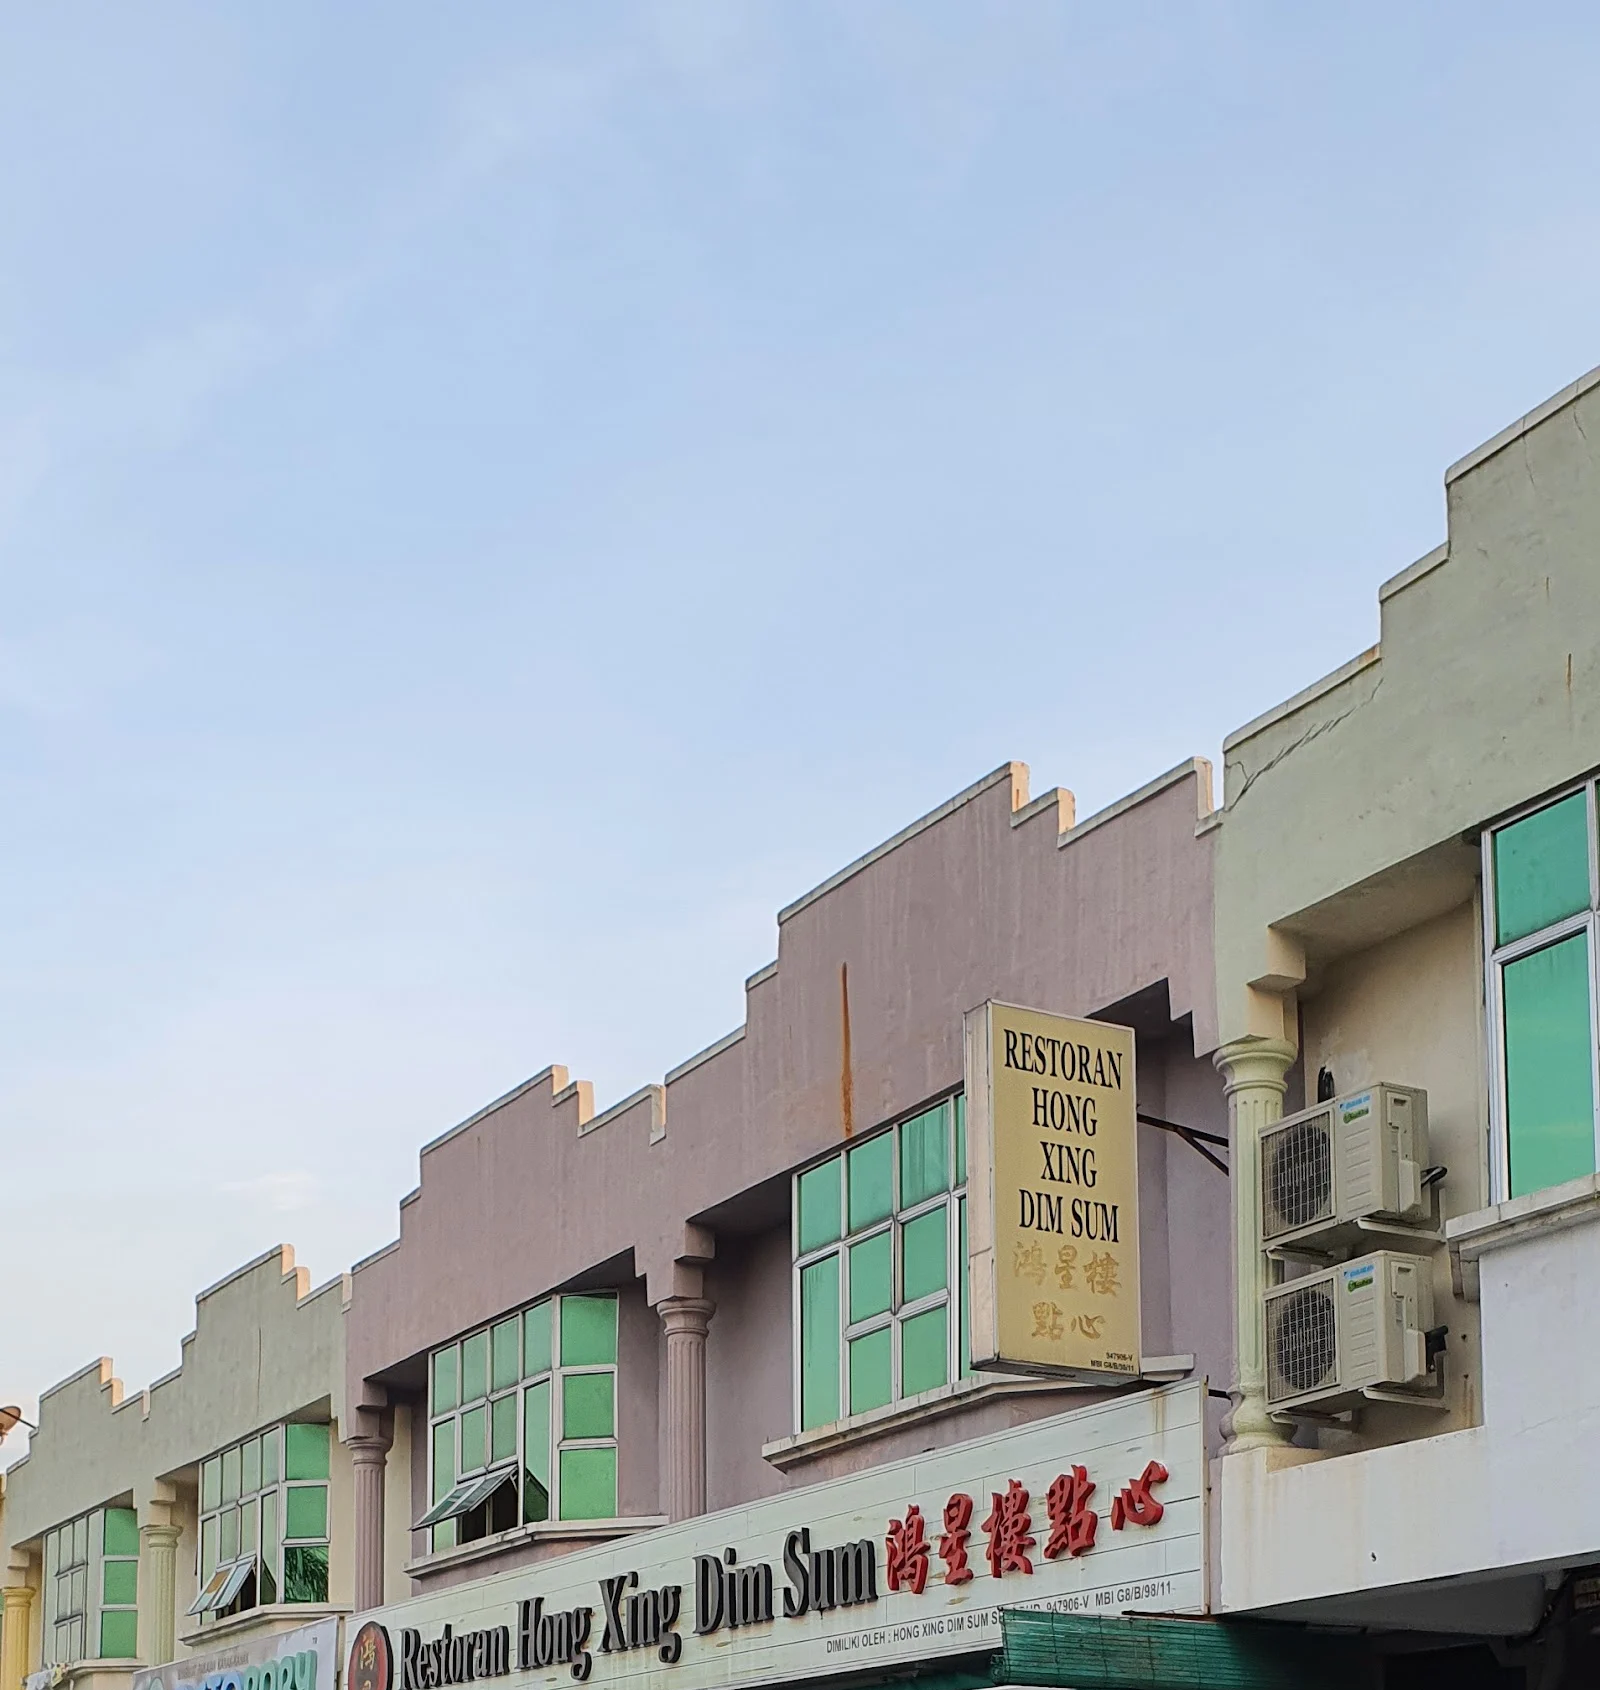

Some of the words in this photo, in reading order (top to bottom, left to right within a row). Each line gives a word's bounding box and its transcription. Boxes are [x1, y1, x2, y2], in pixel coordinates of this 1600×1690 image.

[1004, 1029, 1122, 1090] RESTORAN
[1032, 1087, 1097, 1136] HONG
[1040, 1141, 1097, 1187] XING
[1019, 1189, 1063, 1234] DIM
[1071, 1198, 1119, 1243] SUM
[1031, 1302, 1106, 1340] 點心
[886, 1460, 1169, 1594] 鴻星樓點心
[399, 1624, 510, 1690] Restoran
[515, 1596, 593, 1681] Hong
[598, 1571, 682, 1664] Xing
[692, 1547, 775, 1636] Dim
[784, 1527, 879, 1618] Sum
[1095, 1590, 1114, 1606] MBI
[1117, 1580, 1171, 1602] G8/B/98/11
[826, 1637, 860, 1653] DIMILIKI
[862, 1631, 885, 1647] OLEH
[894, 1624, 920, 1641] HONG
[922, 1620, 944, 1637] XING
[947, 1617, 965, 1632] DIM
[967, 1614, 989, 1629] SUM
